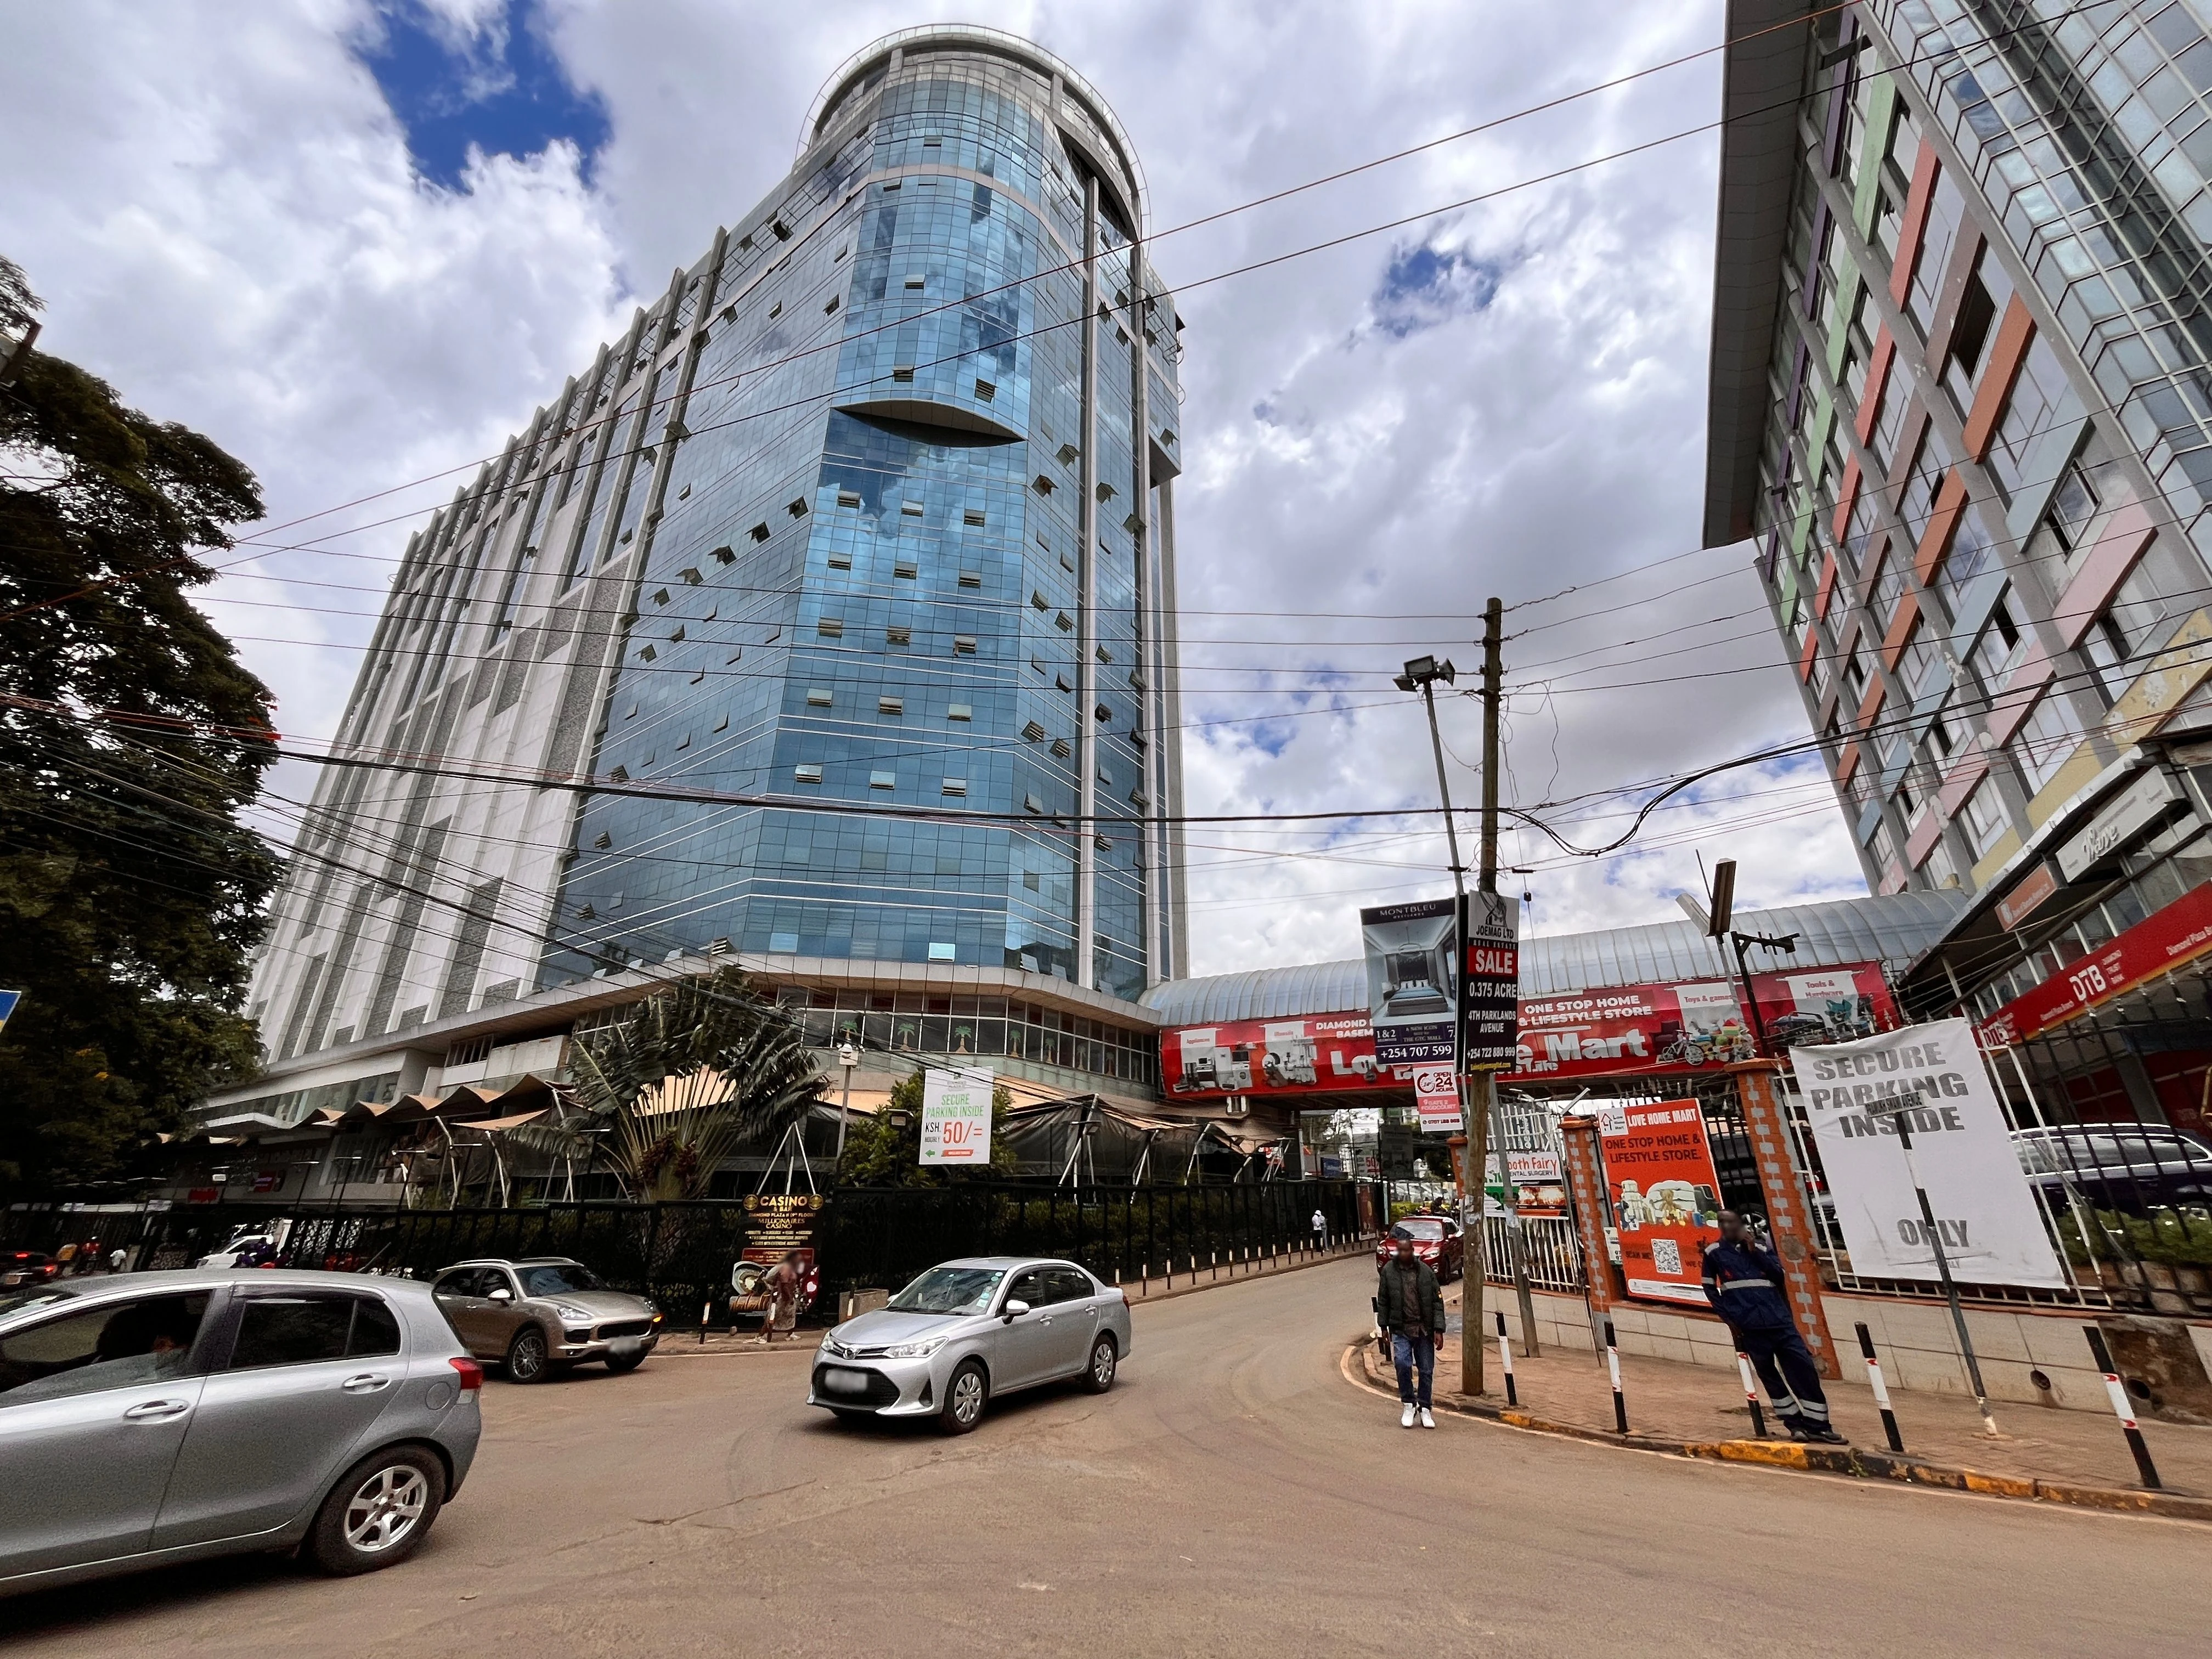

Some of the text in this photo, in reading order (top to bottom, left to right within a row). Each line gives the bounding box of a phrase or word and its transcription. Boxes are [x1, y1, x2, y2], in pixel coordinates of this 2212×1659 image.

[1380, 904, 1436, 916] MONTBLEU
[1476, 925, 1514, 939] JOEMAG LTD
[1475, 949, 1513, 974] SALE
[1469, 982, 1517, 998] 0.375 ACRE
[2069, 965, 2107, 1001] DTB
[1525, 995, 1640, 1014] ONE STOP HOME
[1468, 1010, 1516, 1021] 4TH PARKLANDS
[1518, 1006, 1653, 1026] & LIFESTYLE STORE
[1316, 1018, 1367, 1030] DIAMOND
[1480, 1023, 1504, 1033] AVENUE
[1336, 1028, 1374, 1039] BASEM
[1380, 1045, 1452, 1058] +254 707 599
[1467, 1047, 1481, 1059] +254
[1481, 1047, 1492, 1058] 722
[1505, 1046, 1516, 1057] 999
[1543, 1028, 1648, 1063] Mart
[1813, 1042, 1946, 1080] SECURE
[1435, 1077, 1453, 1087] 24
[1810, 1072, 1969, 1110] PARKING
[941, 1093, 970, 1105] SECURE
[926, 1105, 985, 1119] PARKING INSIDE
[1627, 1108, 1697, 1127] LOVE HOME MART
[1838, 1106, 1966, 1138] INSIDE
[1605, 1133, 1700, 1149] ONE STOP HOME &
[1610, 1151, 1661, 1164] LIFESTYLE
[1508, 1157, 1557, 1176] ooth Fairy
[760, 1196, 808, 1206] CASINO
